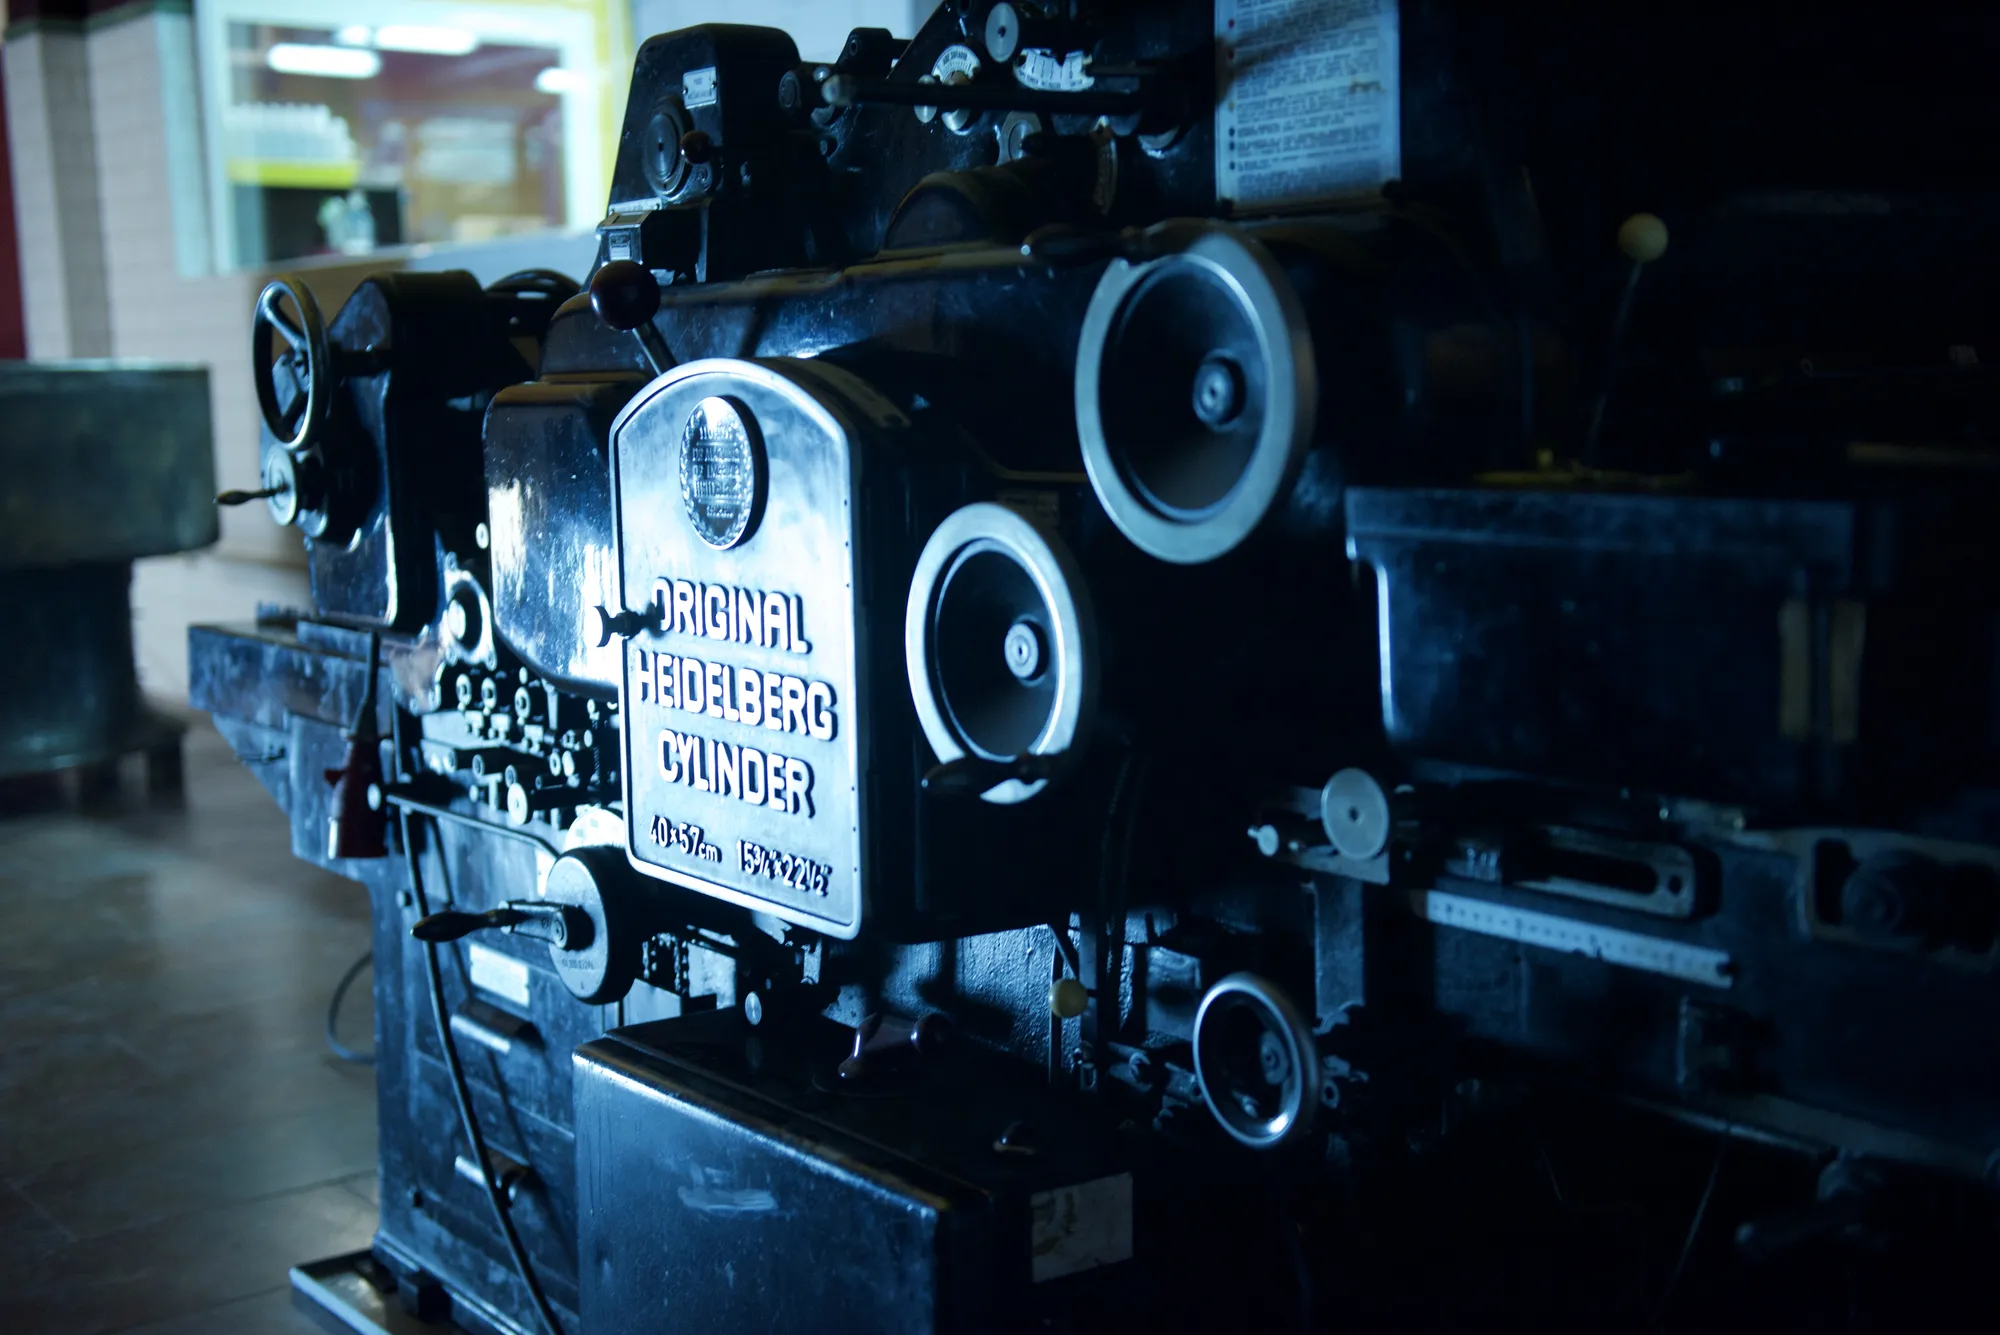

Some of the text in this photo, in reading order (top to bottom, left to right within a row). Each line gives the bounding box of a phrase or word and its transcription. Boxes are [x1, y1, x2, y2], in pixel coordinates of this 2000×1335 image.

[651, 577, 811, 654] ORIGINAL
[636, 649, 838, 741] HEIDELBERG
[657, 728, 815, 818] CYLINDER
